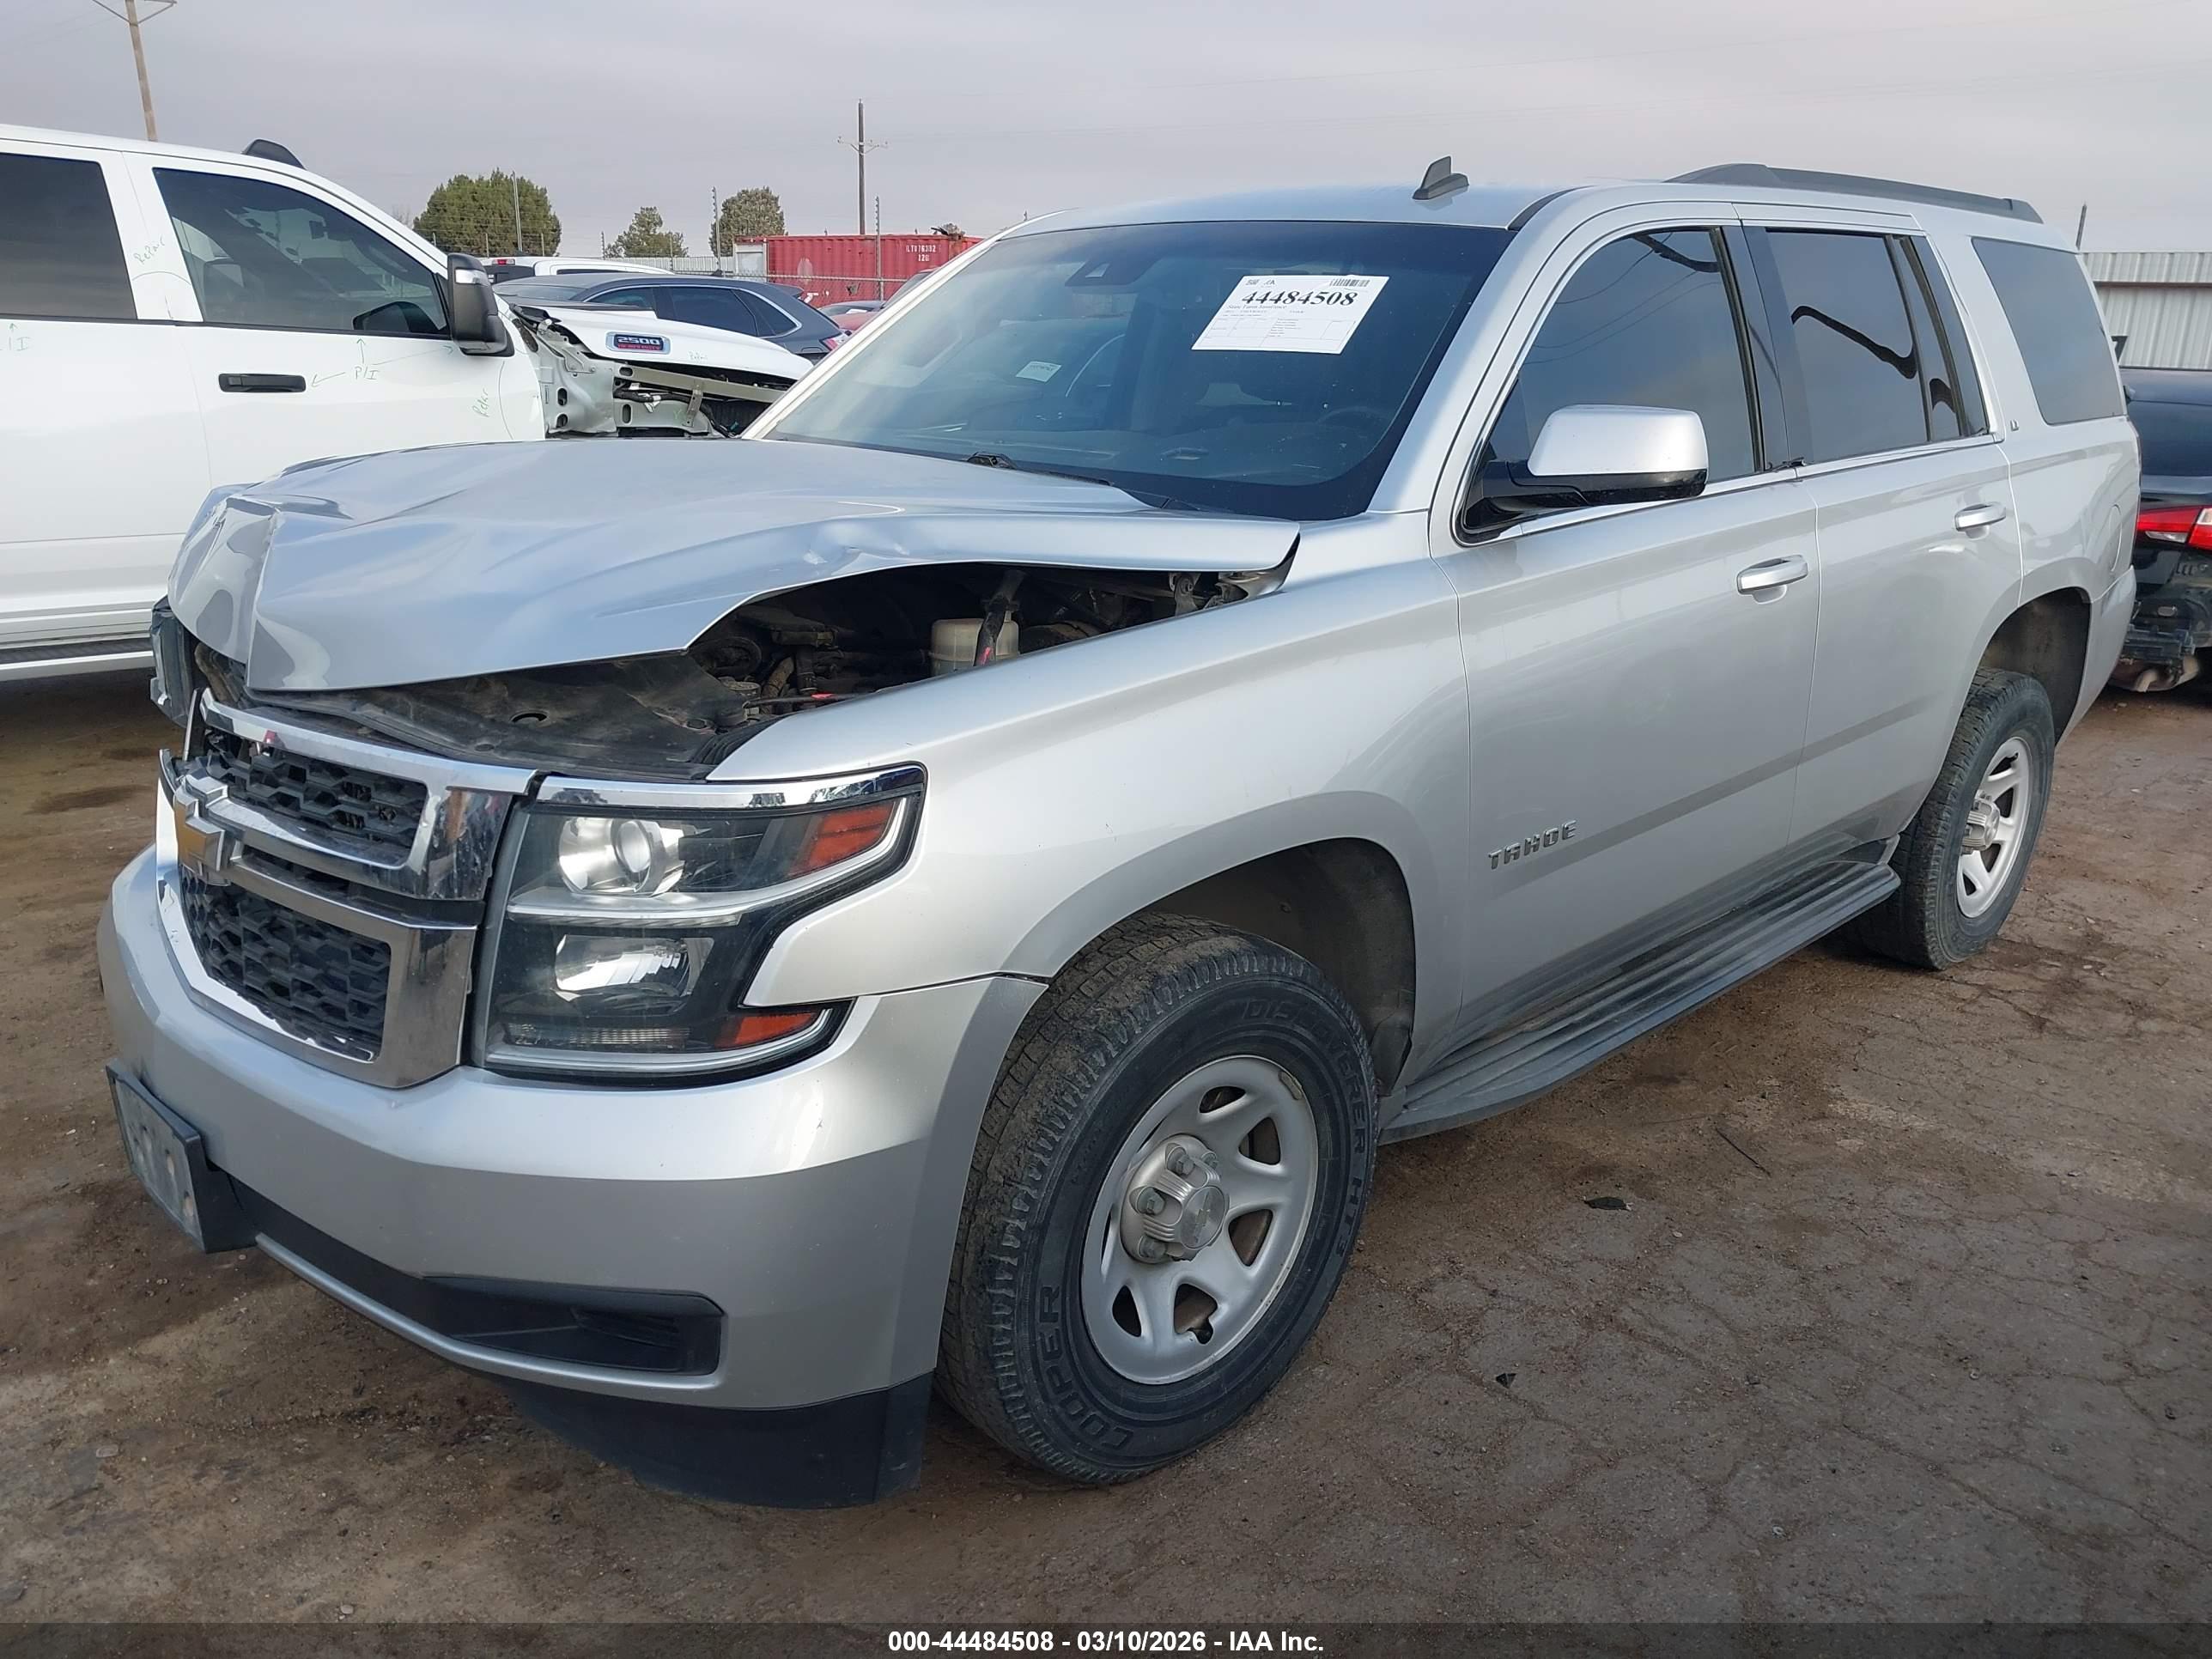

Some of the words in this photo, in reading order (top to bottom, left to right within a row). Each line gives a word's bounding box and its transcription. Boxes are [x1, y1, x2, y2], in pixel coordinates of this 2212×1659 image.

[1242, 290, 1358, 306] 44484508
[617, 336, 660, 345] 2500
[1488, 820, 1577, 870] TAHOE
[1241, 997, 1366, 1155] DISCOVERER
[1039, 1285, 1134, 1449] COOPER
